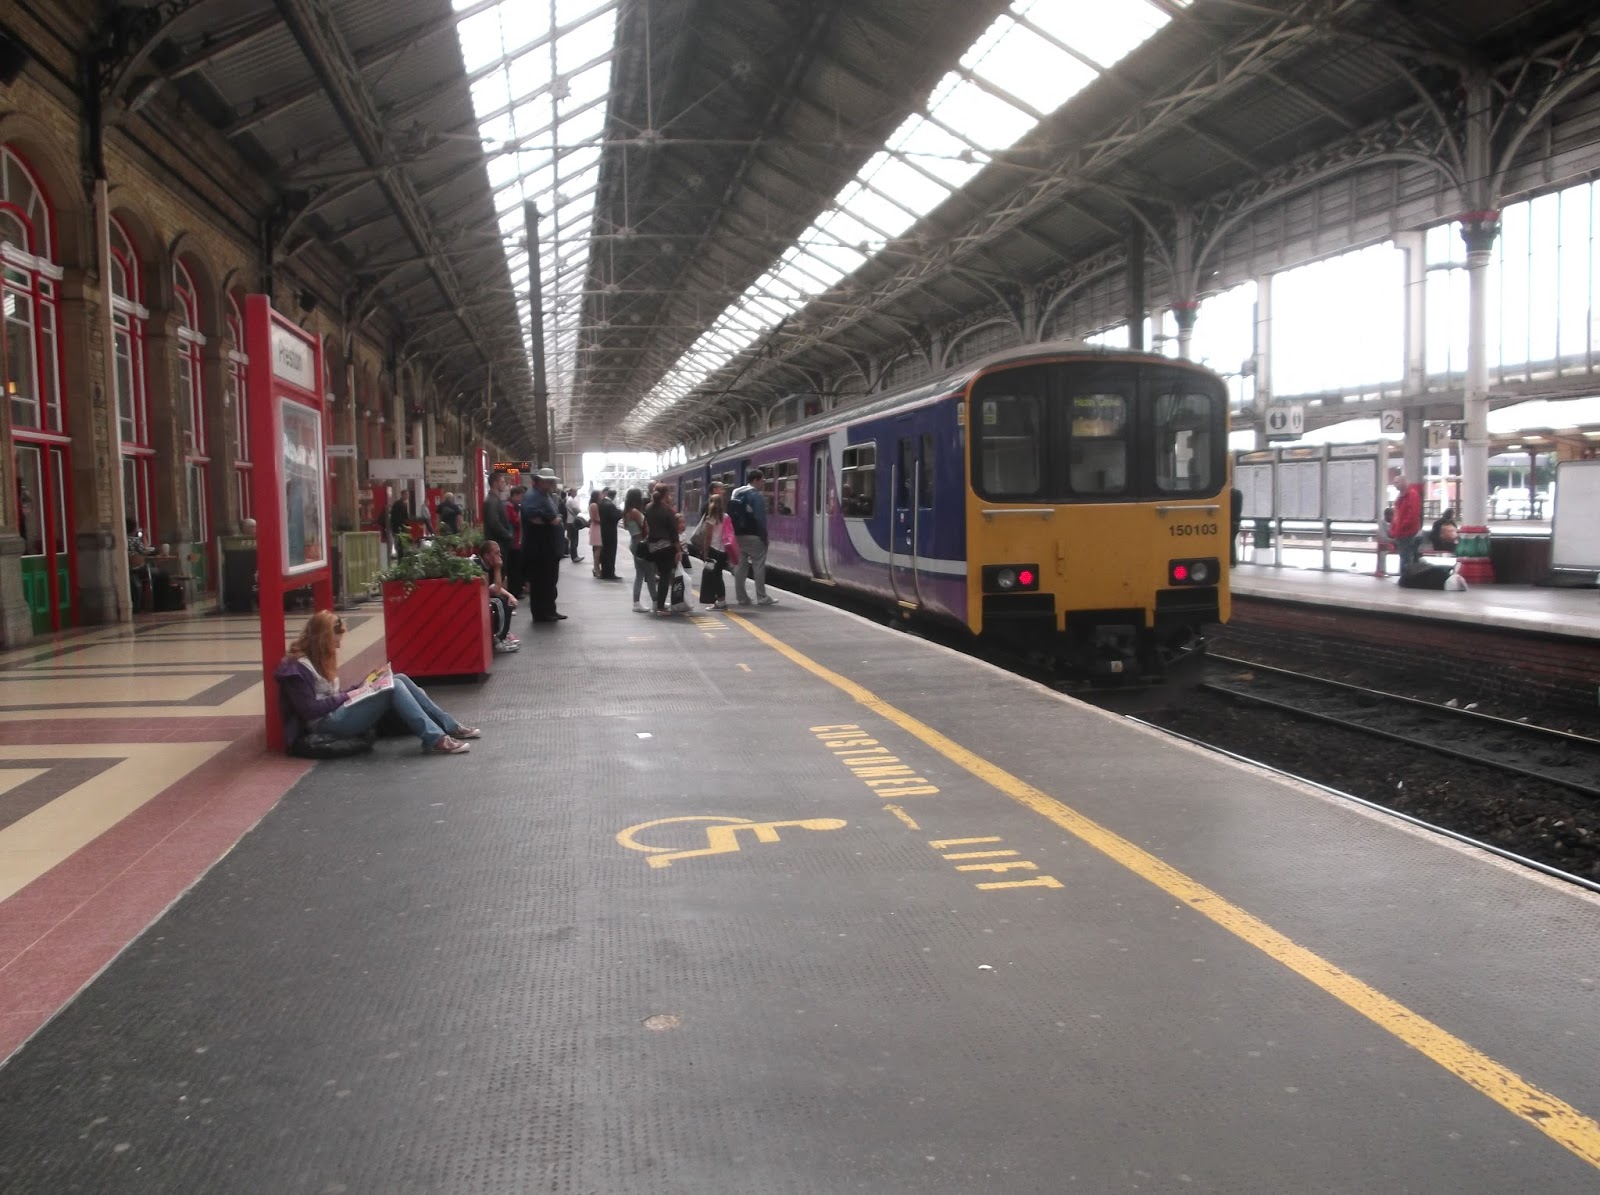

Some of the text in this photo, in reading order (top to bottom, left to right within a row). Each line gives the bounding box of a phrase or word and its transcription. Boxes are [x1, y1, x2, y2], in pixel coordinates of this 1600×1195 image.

[278, 338, 303, 373] Preston
[1168, 523, 1218, 537] 150103
[809, 723, 940, 798] CUSTOMER
[928, 835, 1066, 891] LIFT
